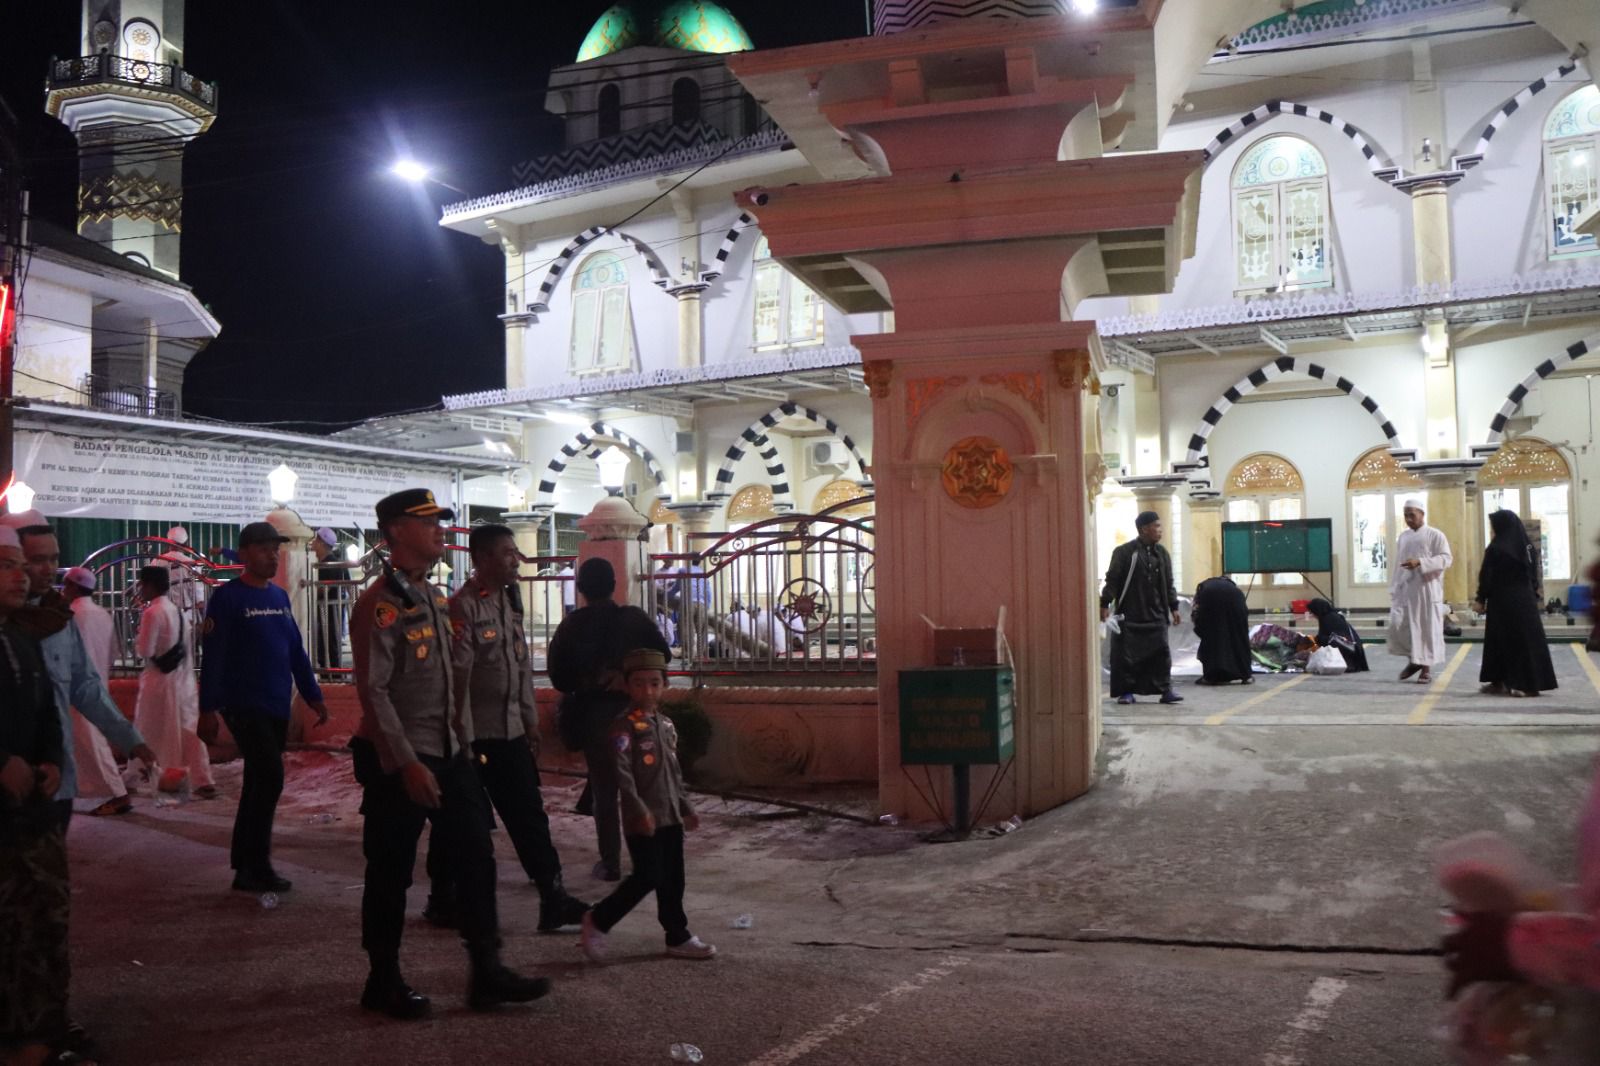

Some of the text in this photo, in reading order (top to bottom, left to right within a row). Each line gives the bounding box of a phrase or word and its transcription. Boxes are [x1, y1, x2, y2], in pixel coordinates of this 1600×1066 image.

[74, 441, 111, 452] BADAN
[114, 444, 172, 456] PENGELOLA
[175, 450, 208, 460] MASJID
[211, 453, 222, 462] AL
